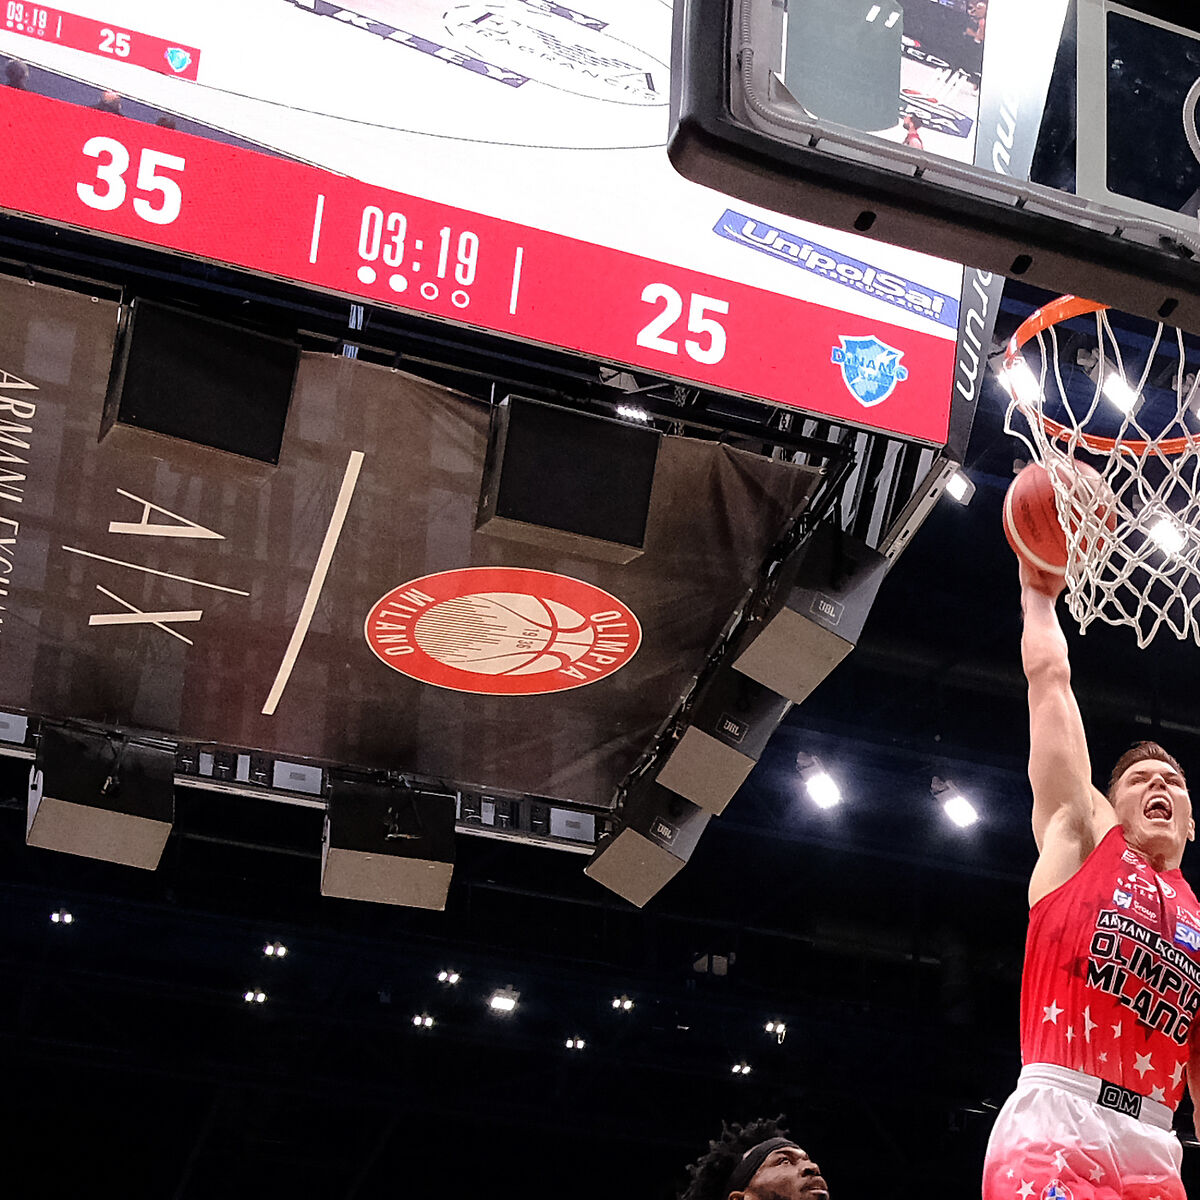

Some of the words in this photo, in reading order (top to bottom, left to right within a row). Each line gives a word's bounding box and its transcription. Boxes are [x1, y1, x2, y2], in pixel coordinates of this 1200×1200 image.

[99, 28, 131, 57] 25
[76, 137, 187, 225] 35
[358, 205, 480, 287] 03:19
[741, 219, 945, 314] UnipolSai
[636, 282, 730, 366] 25
[375, 588, 436, 656] MILANO
[558, 610, 631, 681] OLIMPIA
[1099, 913, 1151, 944] ARMANI
[1086, 956, 1192, 1047] MILANO
[1102, 1086, 1142, 1118] OM
